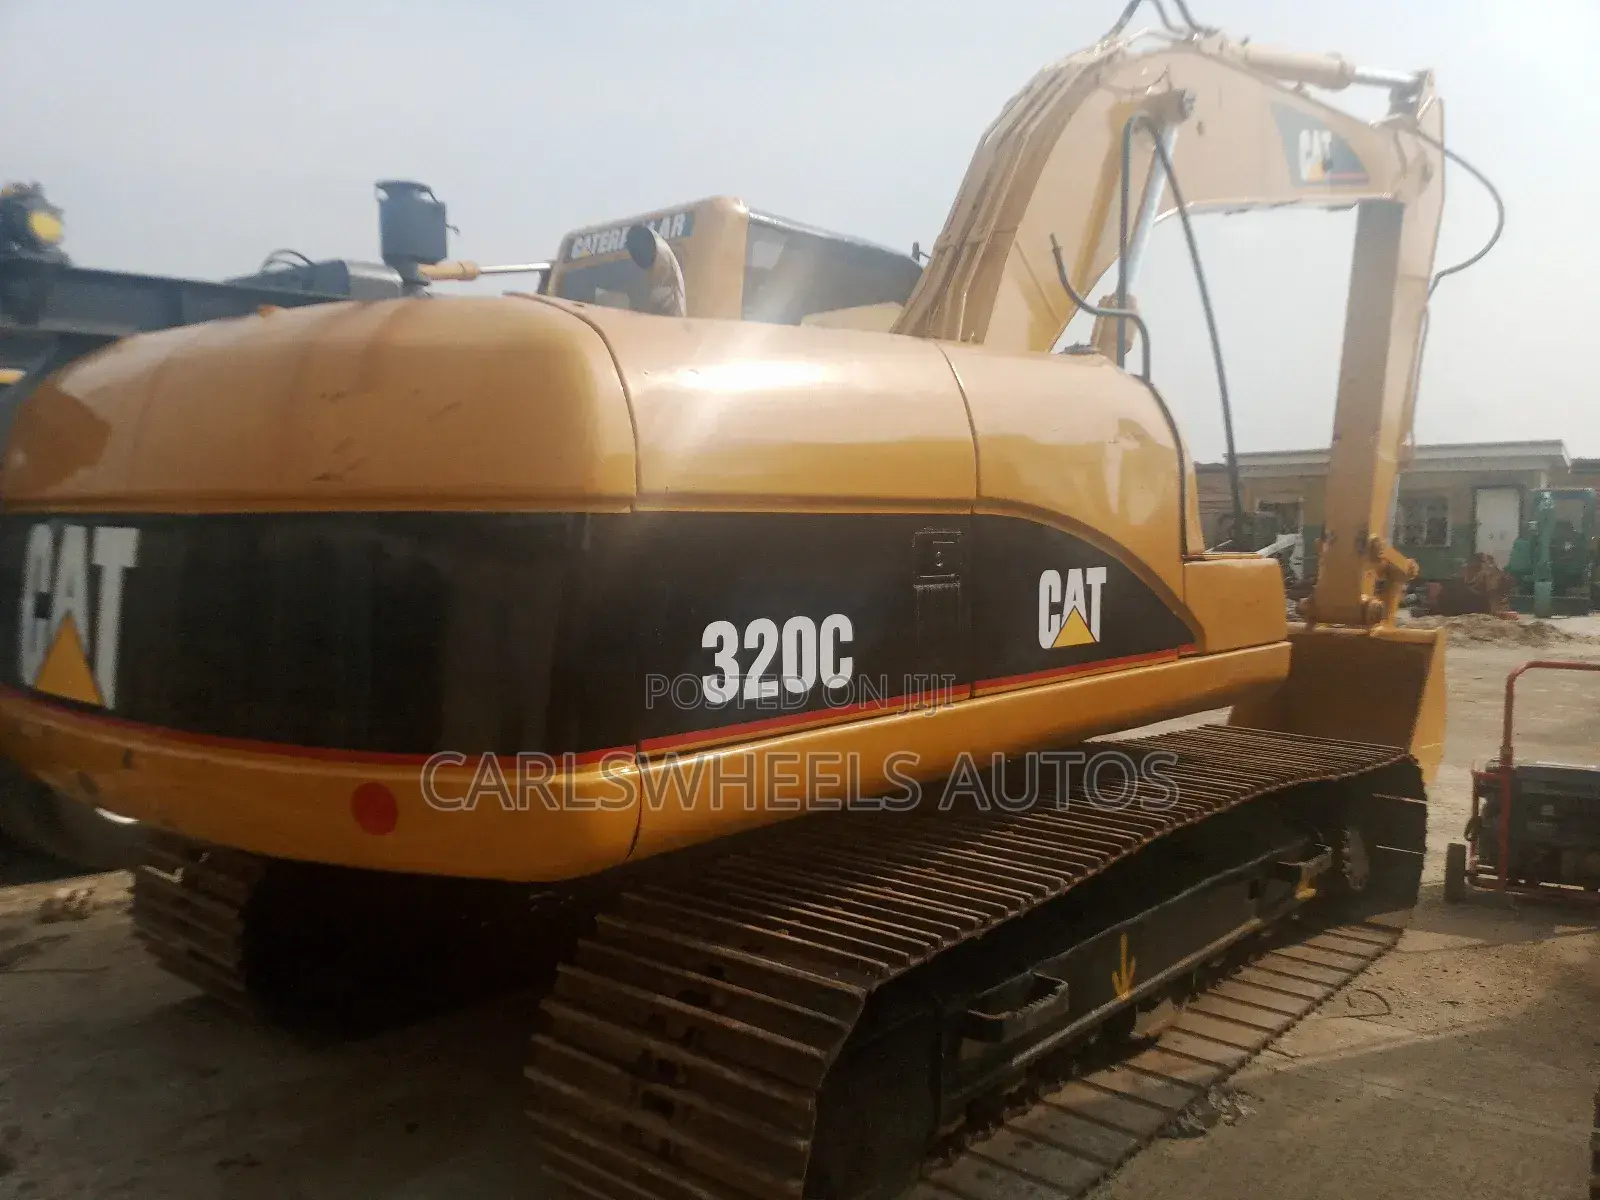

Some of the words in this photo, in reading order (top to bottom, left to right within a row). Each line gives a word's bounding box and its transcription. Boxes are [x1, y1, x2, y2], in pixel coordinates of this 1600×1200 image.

[1299, 129, 1332, 182] CAT
[19, 523, 141, 710] CAT
[1039, 566, 1107, 649] CAT
[701, 613, 854, 704] 320C
